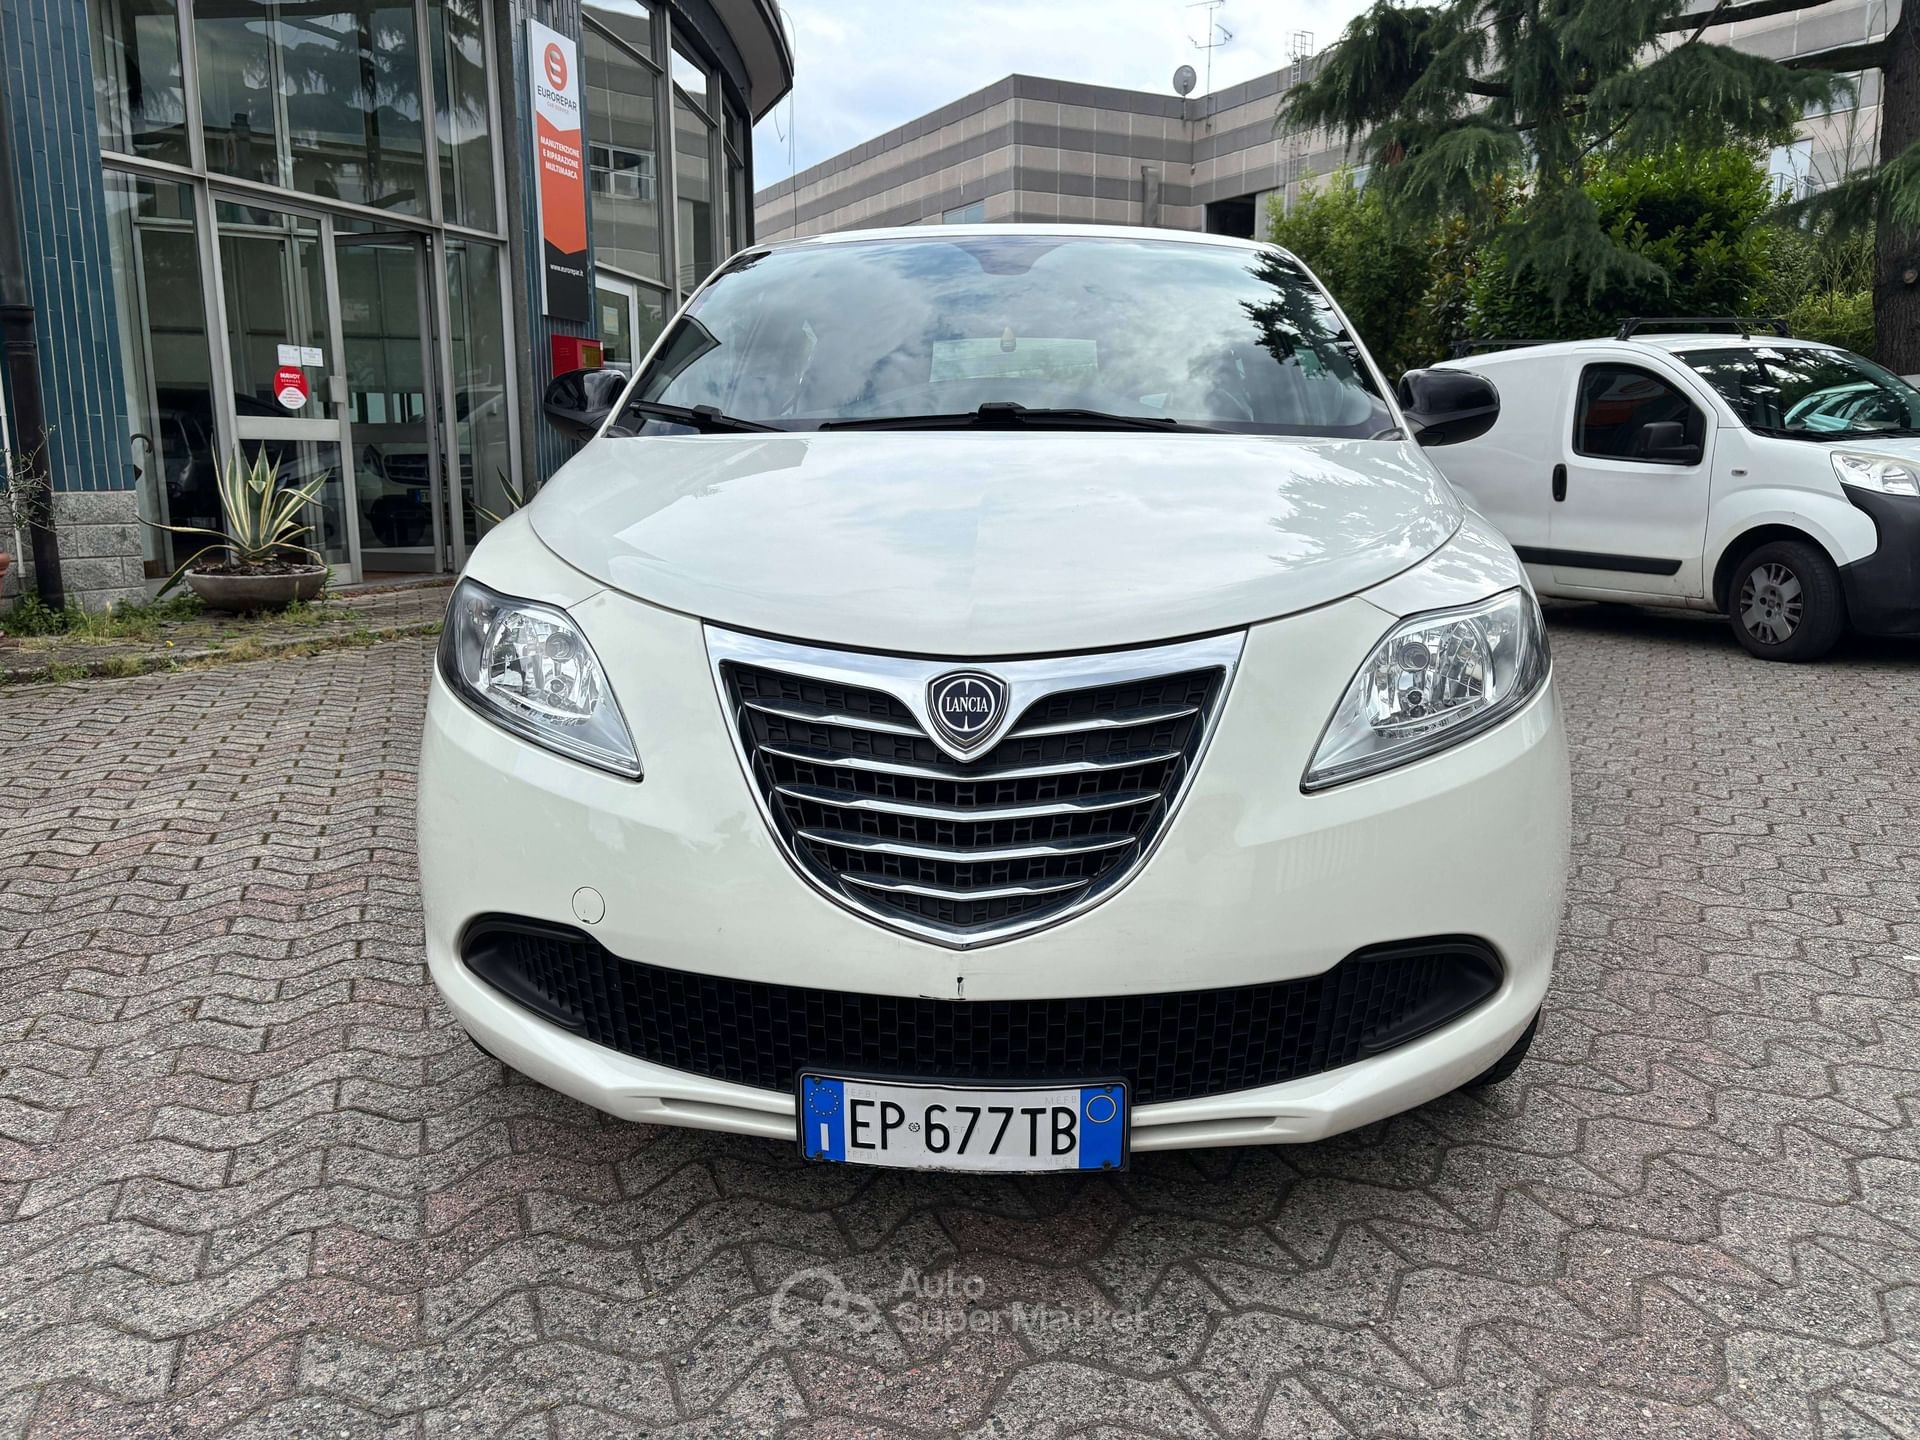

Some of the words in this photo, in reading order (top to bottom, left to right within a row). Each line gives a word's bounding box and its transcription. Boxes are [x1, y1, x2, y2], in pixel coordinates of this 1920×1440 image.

[537, 84, 578, 112] EUROREPAR
[540, 135, 580, 158] MANUTENZIONE
[543, 147, 547, 157] E
[546, 149, 579, 169] RIPARAZIONE
[545, 160, 578, 180] MULTIMARCA
[946, 697, 989, 712] LANCIA
[850, 1099, 905, 1150] EP
[925, 1104, 1077, 1156] 677TB
